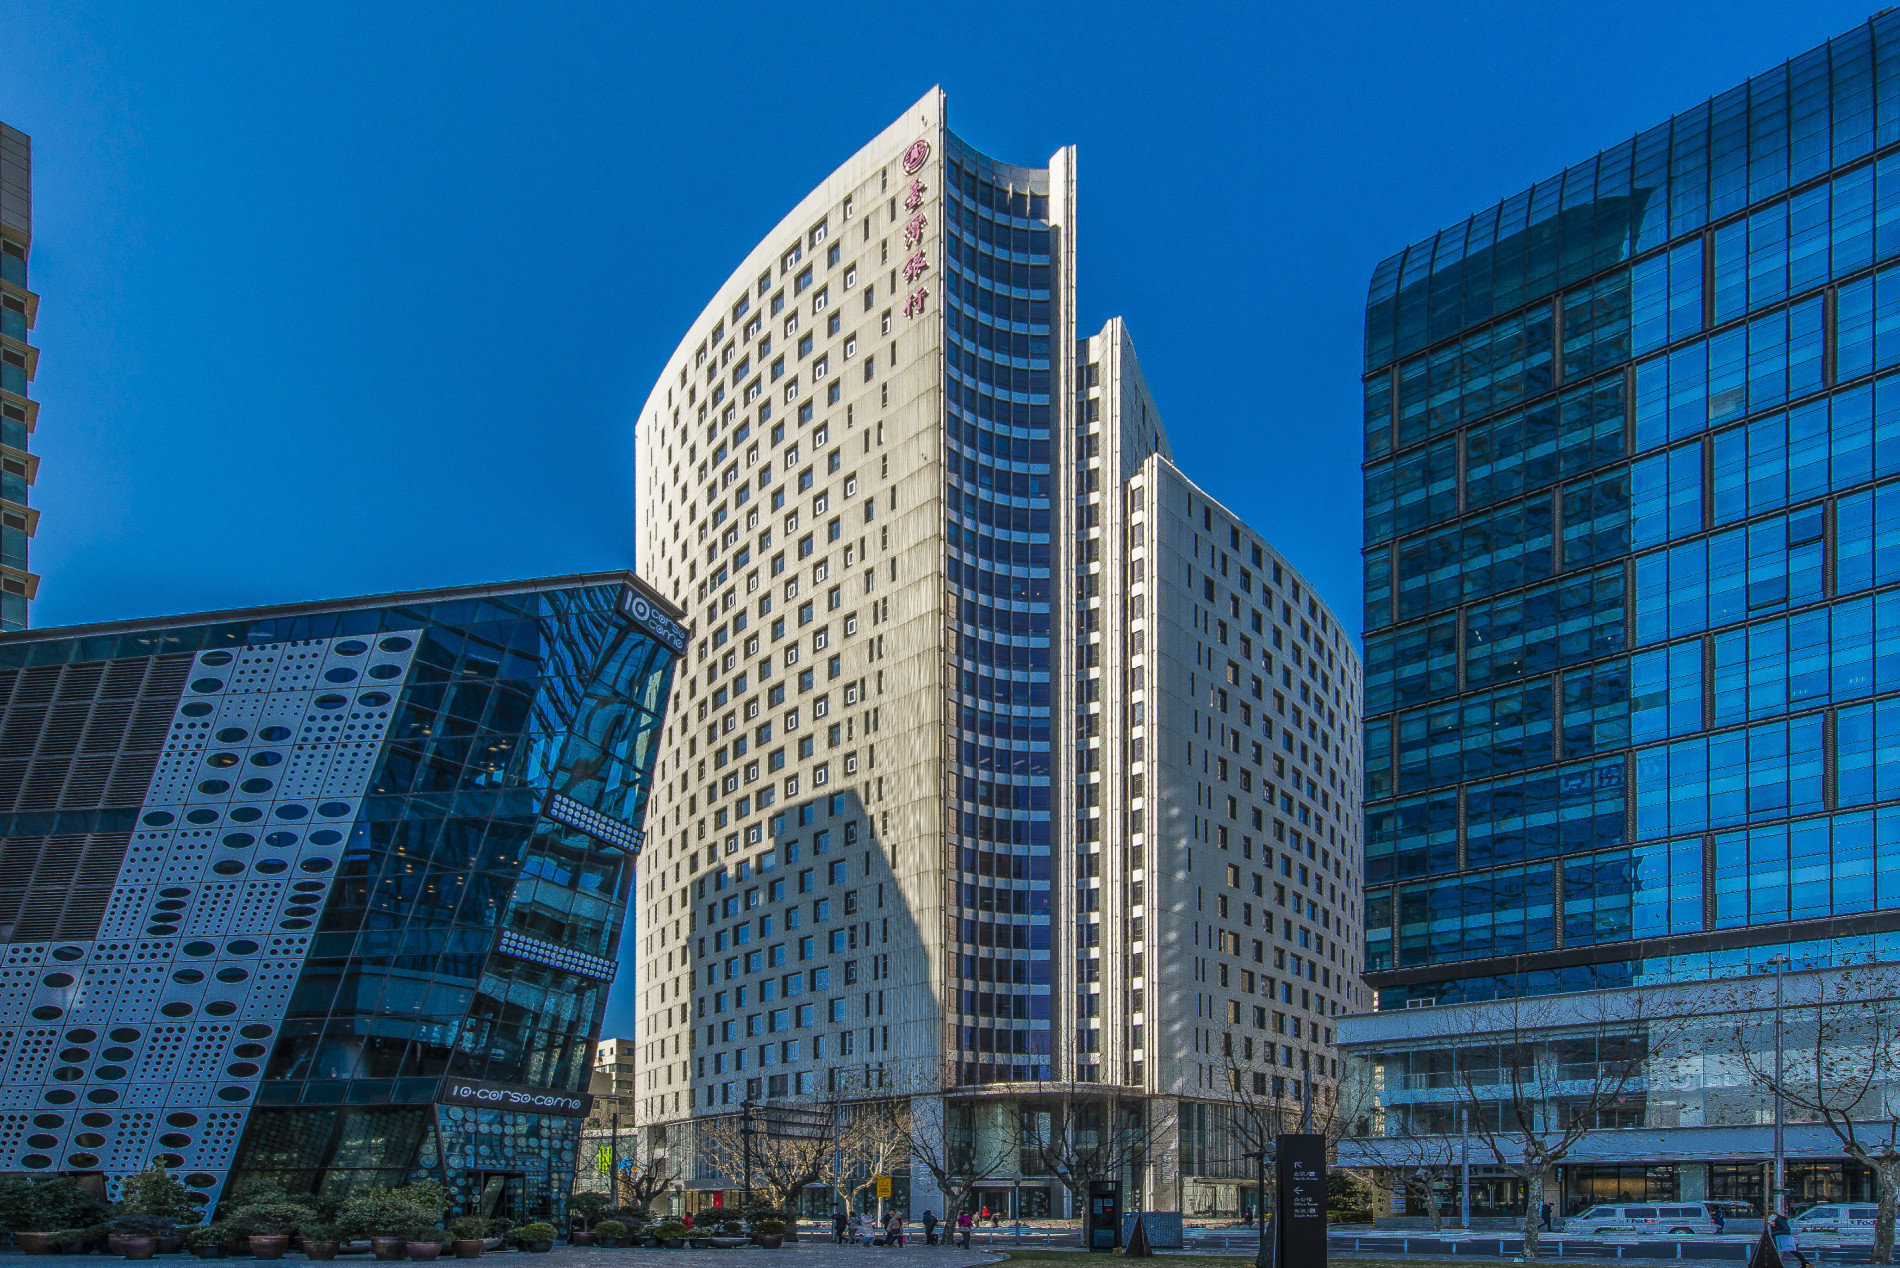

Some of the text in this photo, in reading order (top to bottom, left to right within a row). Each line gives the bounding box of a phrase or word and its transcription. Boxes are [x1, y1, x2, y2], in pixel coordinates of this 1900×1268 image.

[624, 590, 686, 639] 10 corso
[648, 619, 683, 649] como
